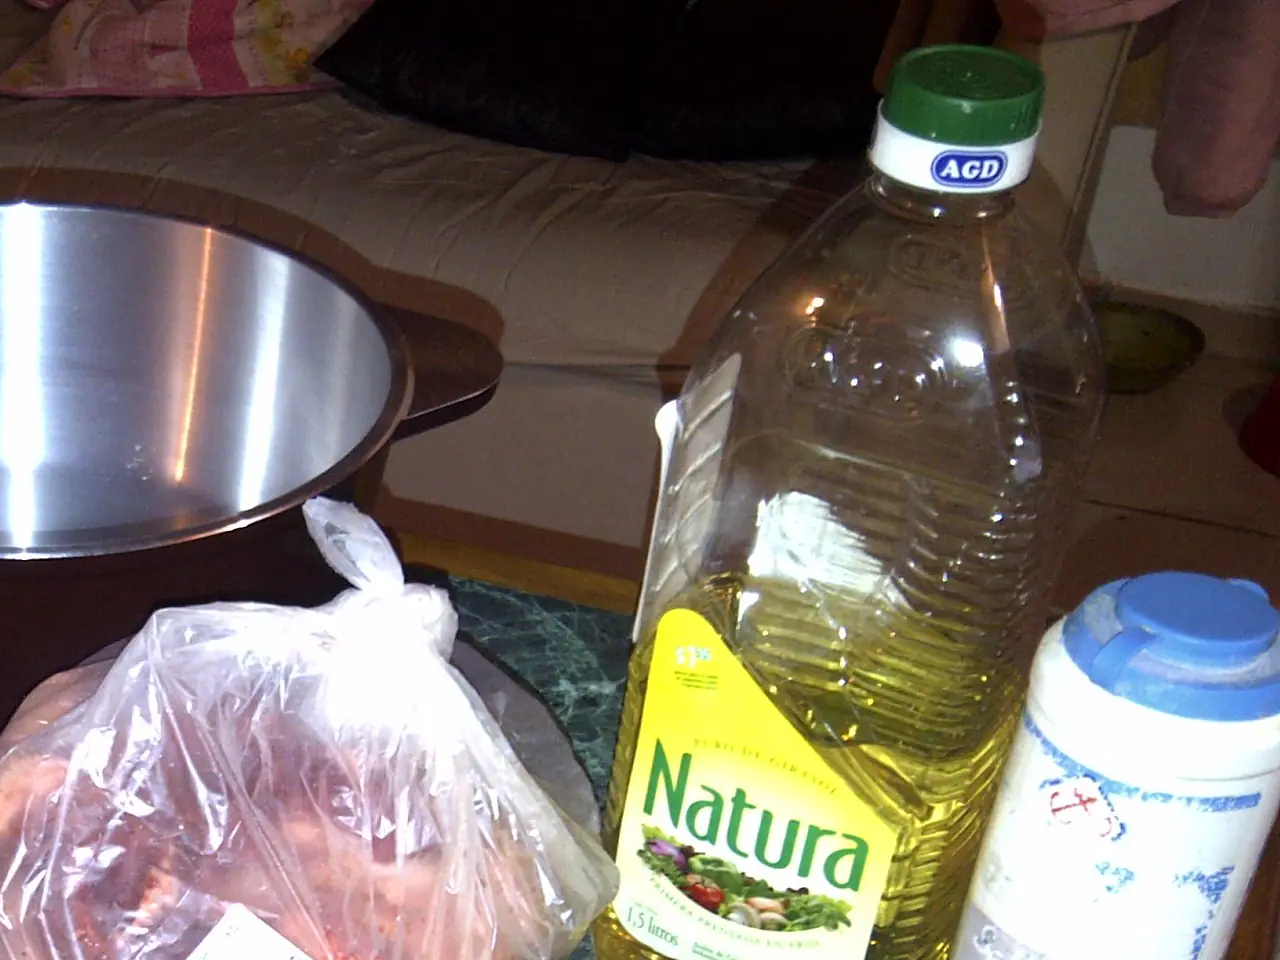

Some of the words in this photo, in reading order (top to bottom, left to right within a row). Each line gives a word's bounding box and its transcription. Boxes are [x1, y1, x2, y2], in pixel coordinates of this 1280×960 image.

[940, 159, 1000, 179] AGD
[643, 737, 870, 892] Natura
[626, 906, 645, 929] 1,5
[648, 915, 679, 946] litros
